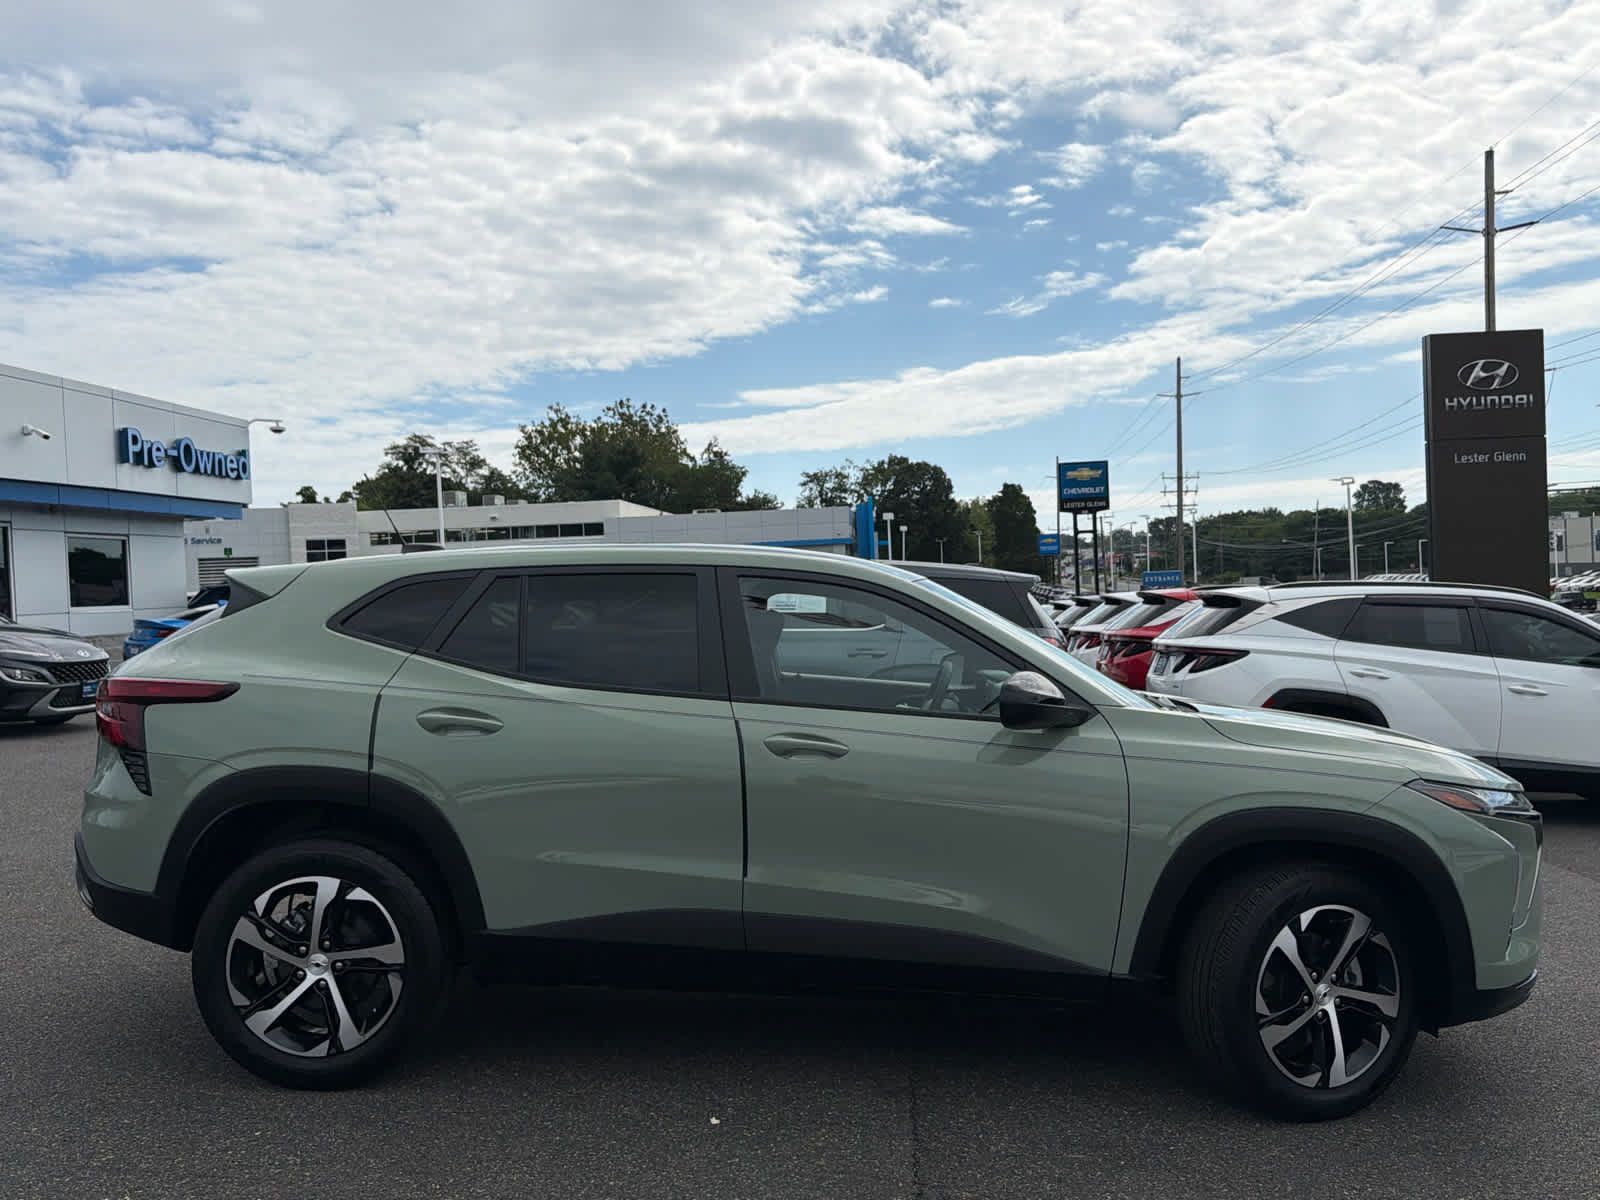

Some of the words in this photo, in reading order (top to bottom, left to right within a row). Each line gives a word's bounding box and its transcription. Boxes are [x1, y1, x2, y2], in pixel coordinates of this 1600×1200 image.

[1444, 393, 1534, 411] HYUNDAI
[120, 427, 249, 480] Pre-Owned
[1454, 452, 1490, 464] Lester
[1494, 450, 1527, 462] Glenn
[1063, 486, 1105, 495] CHEVROLET
[1145, 575, 1181, 583] ENTRANCE
